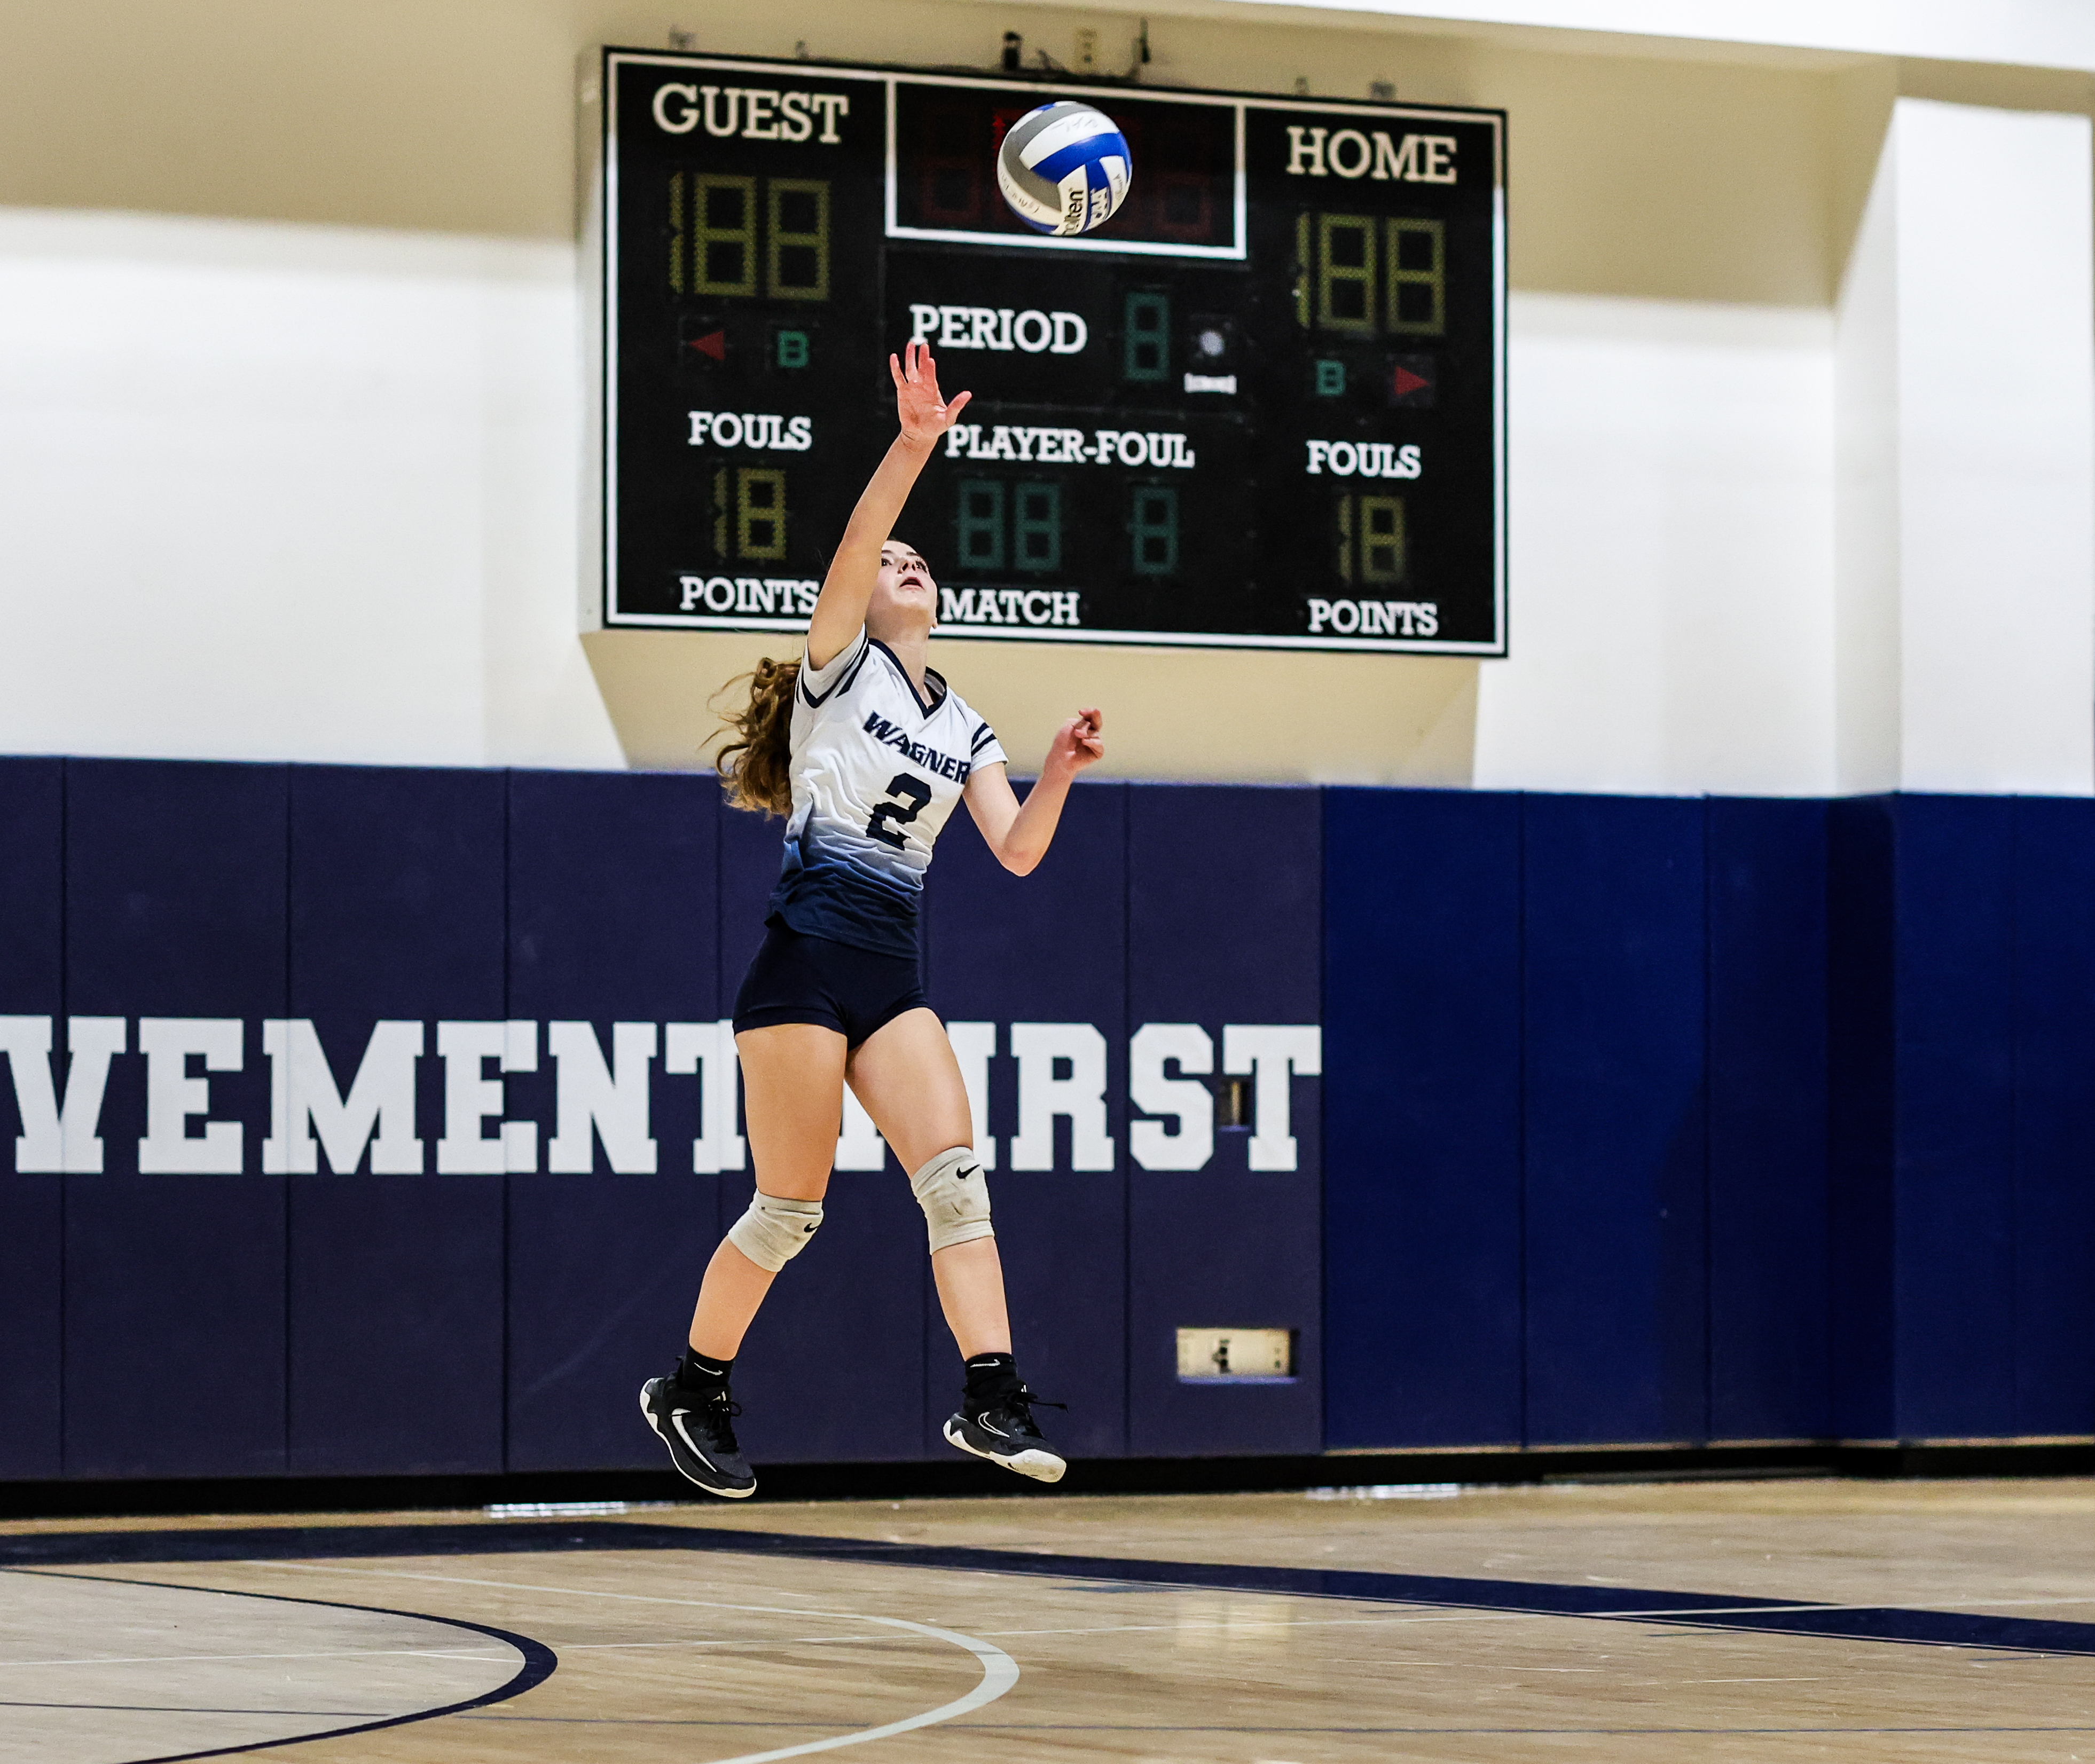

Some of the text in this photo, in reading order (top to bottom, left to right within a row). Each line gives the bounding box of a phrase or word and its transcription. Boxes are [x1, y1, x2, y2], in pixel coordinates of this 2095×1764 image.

[653, 83, 849, 144] GUEST
[1286, 126, 1457, 185] HOME
[909, 304, 1087, 353] PERIOD
[687, 410, 812, 451] FOULS
[944, 424, 1196, 468] PLAYER-FOUL
[1306, 440, 1422, 479] FOULS
[679, 576, 819, 615] POINTS
[939, 588, 1080, 626] MATCH
[1307, 598, 1439, 636] POINTS
[862, 710, 971, 785] WAGNER
[865, 773, 932, 851] 2
[0, 1014, 746, 1174] VEMENT
